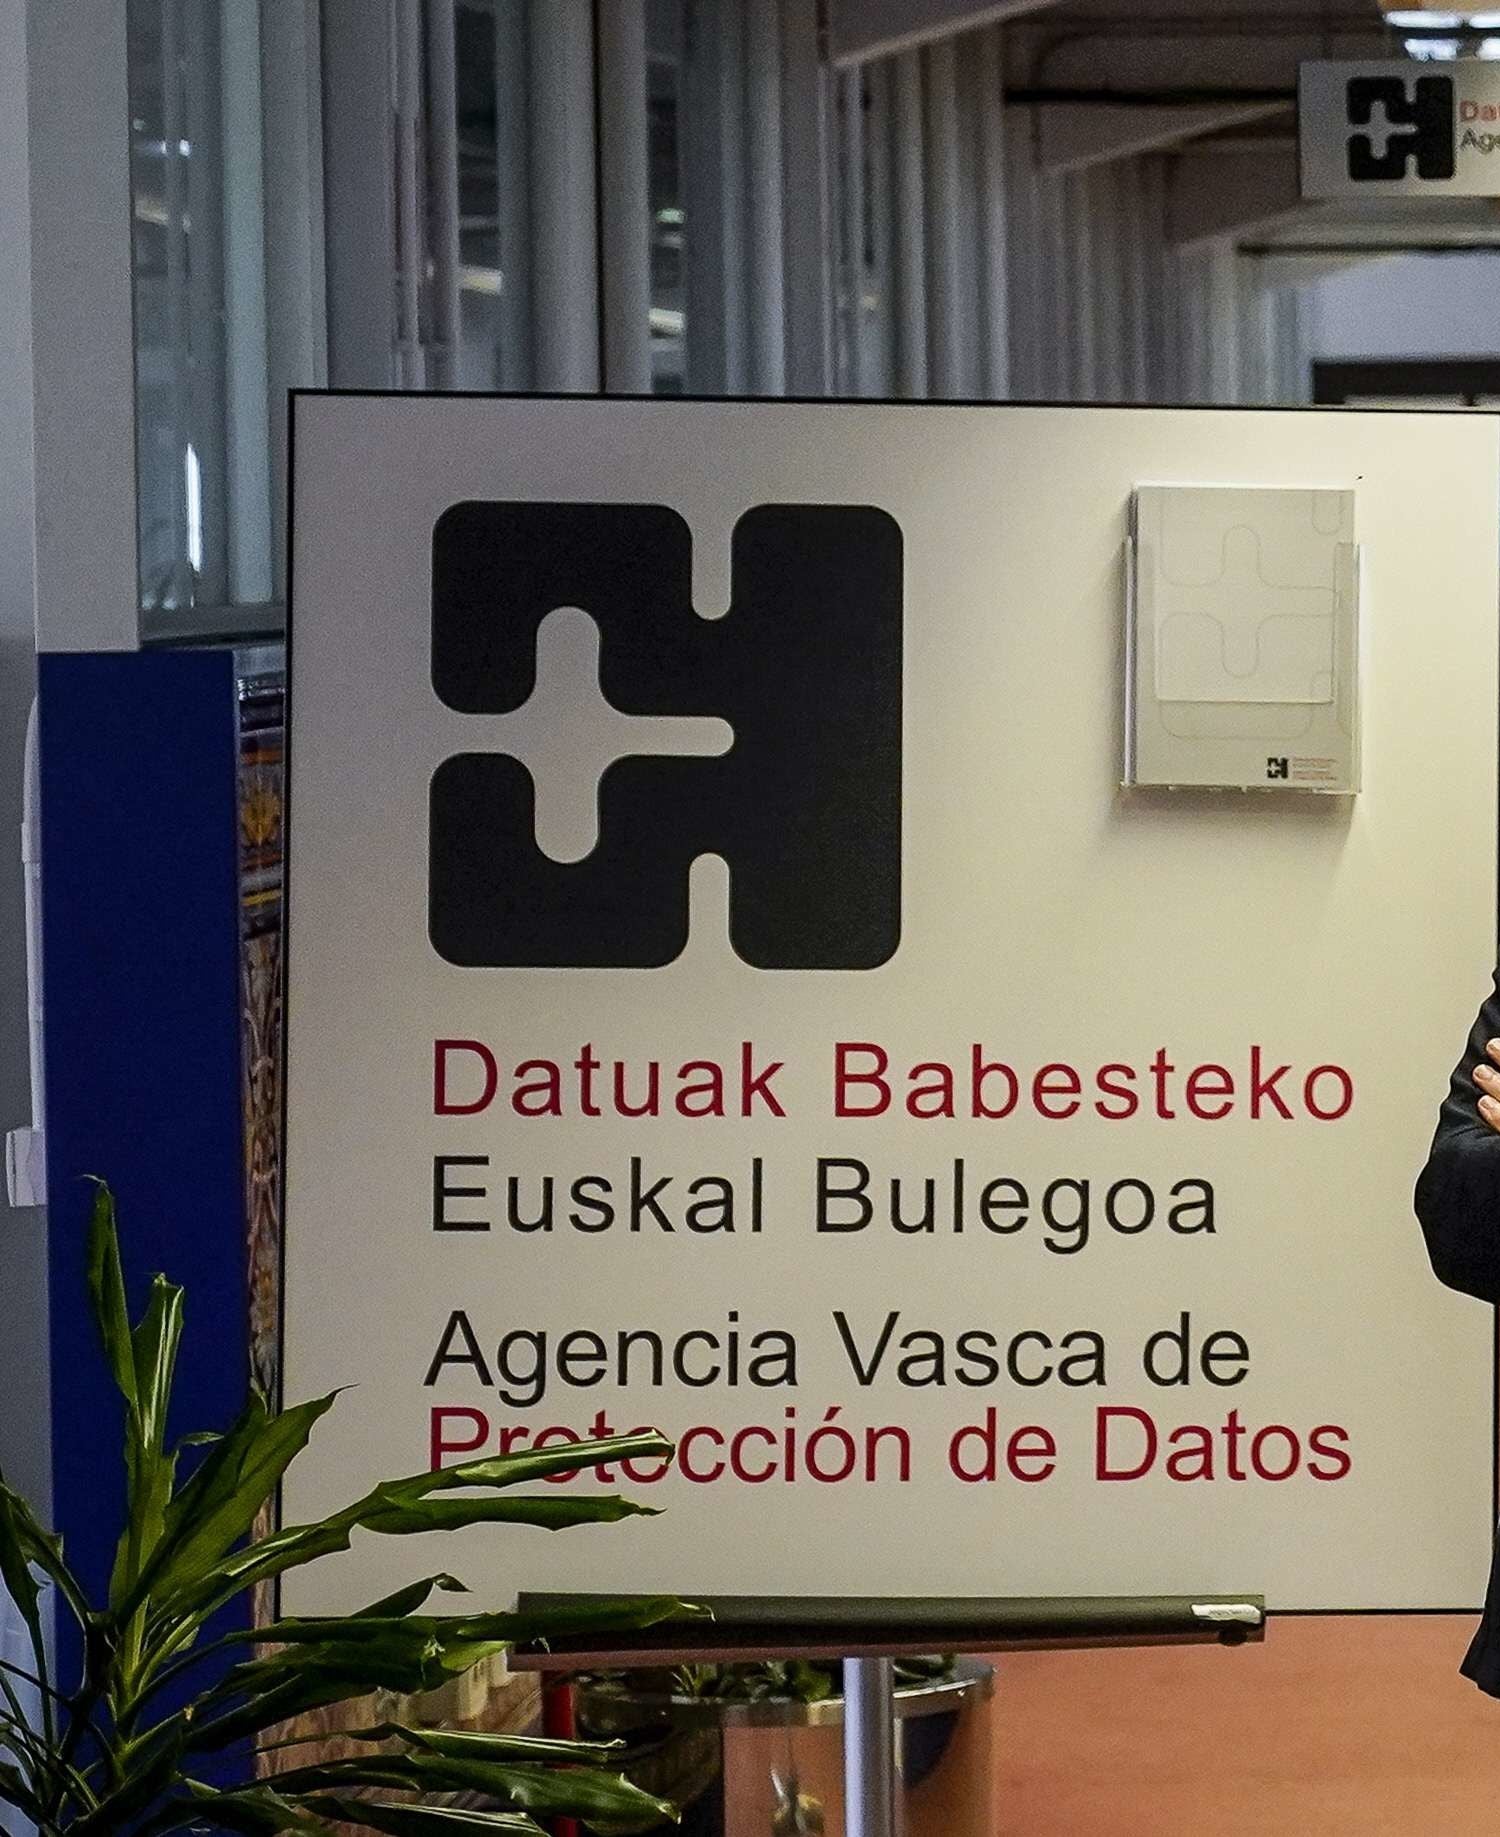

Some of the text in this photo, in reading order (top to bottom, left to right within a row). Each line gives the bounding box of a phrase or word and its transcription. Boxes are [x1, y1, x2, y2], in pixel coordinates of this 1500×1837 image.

[432, 1038, 1355, 1121] Datuak Babesteko
[431, 1154, 1217, 1255] Euskal Bulegoa
[424, 1309, 1250, 1408] Agencia Vasca de
[948, 1406, 1057, 1483] de
[1094, 1406, 1352, 1483] Datos
